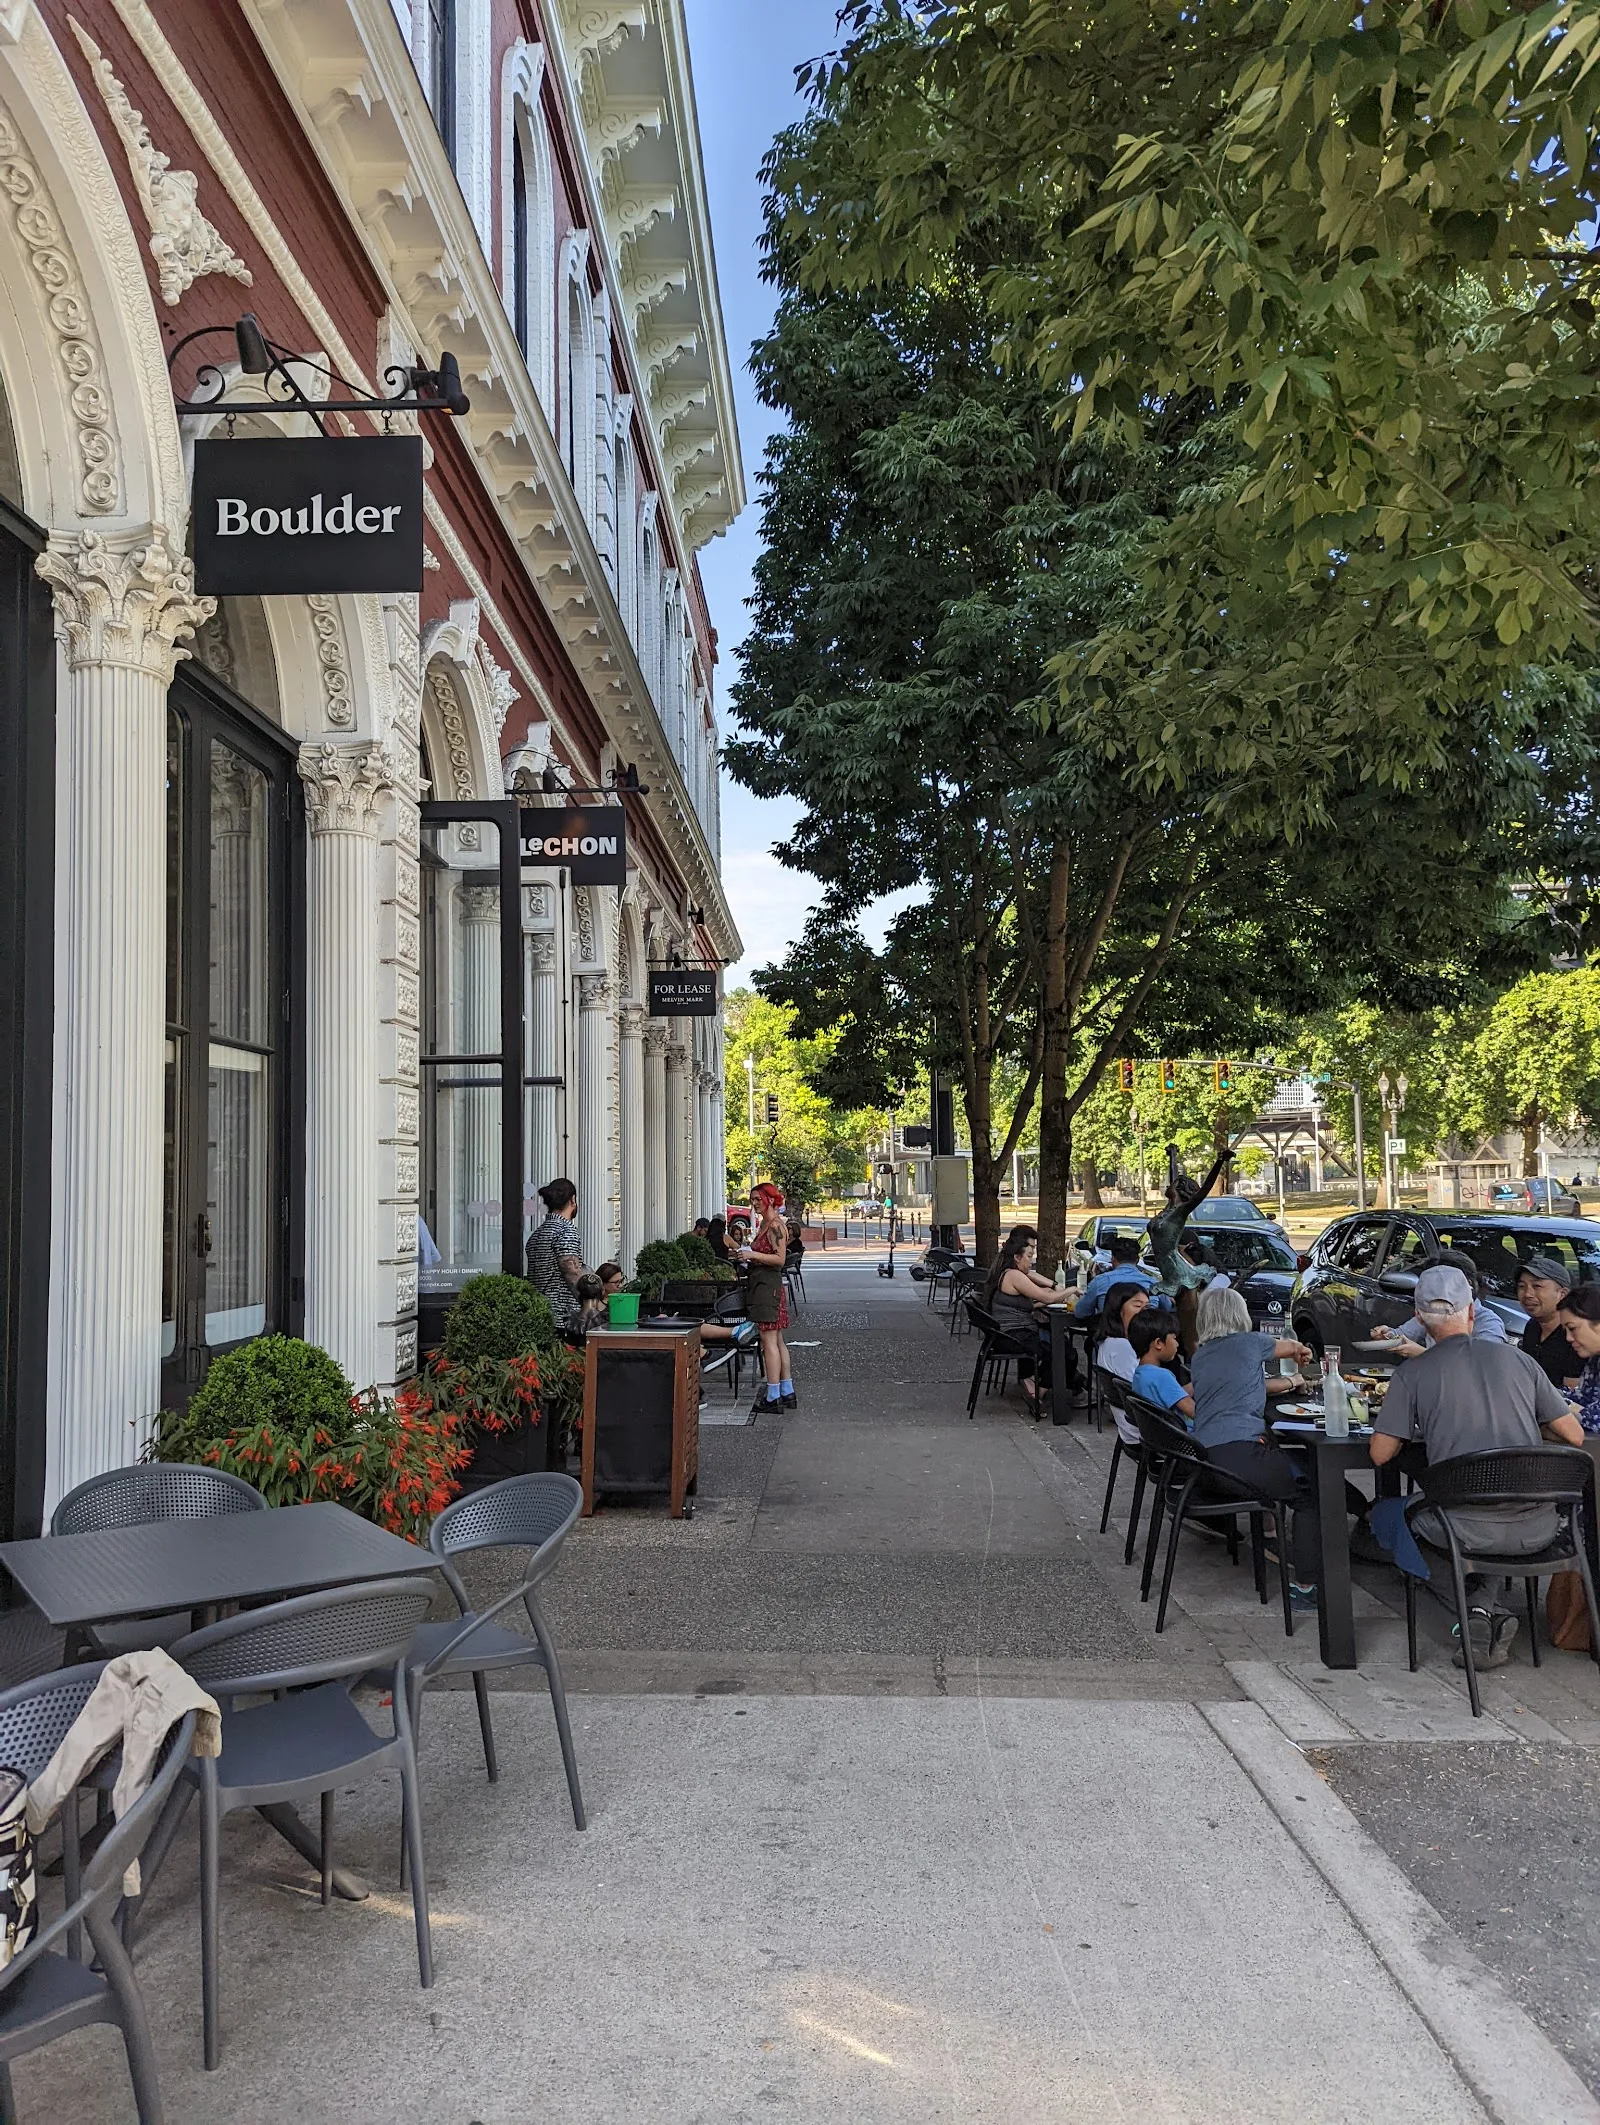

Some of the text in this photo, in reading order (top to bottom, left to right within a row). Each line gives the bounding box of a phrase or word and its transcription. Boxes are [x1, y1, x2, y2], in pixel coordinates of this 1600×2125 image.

[216, 493, 402, 536] Boulder
[654, 984, 711, 994] FOR LEASE
[1390, 1141, 1398, 1151] P
